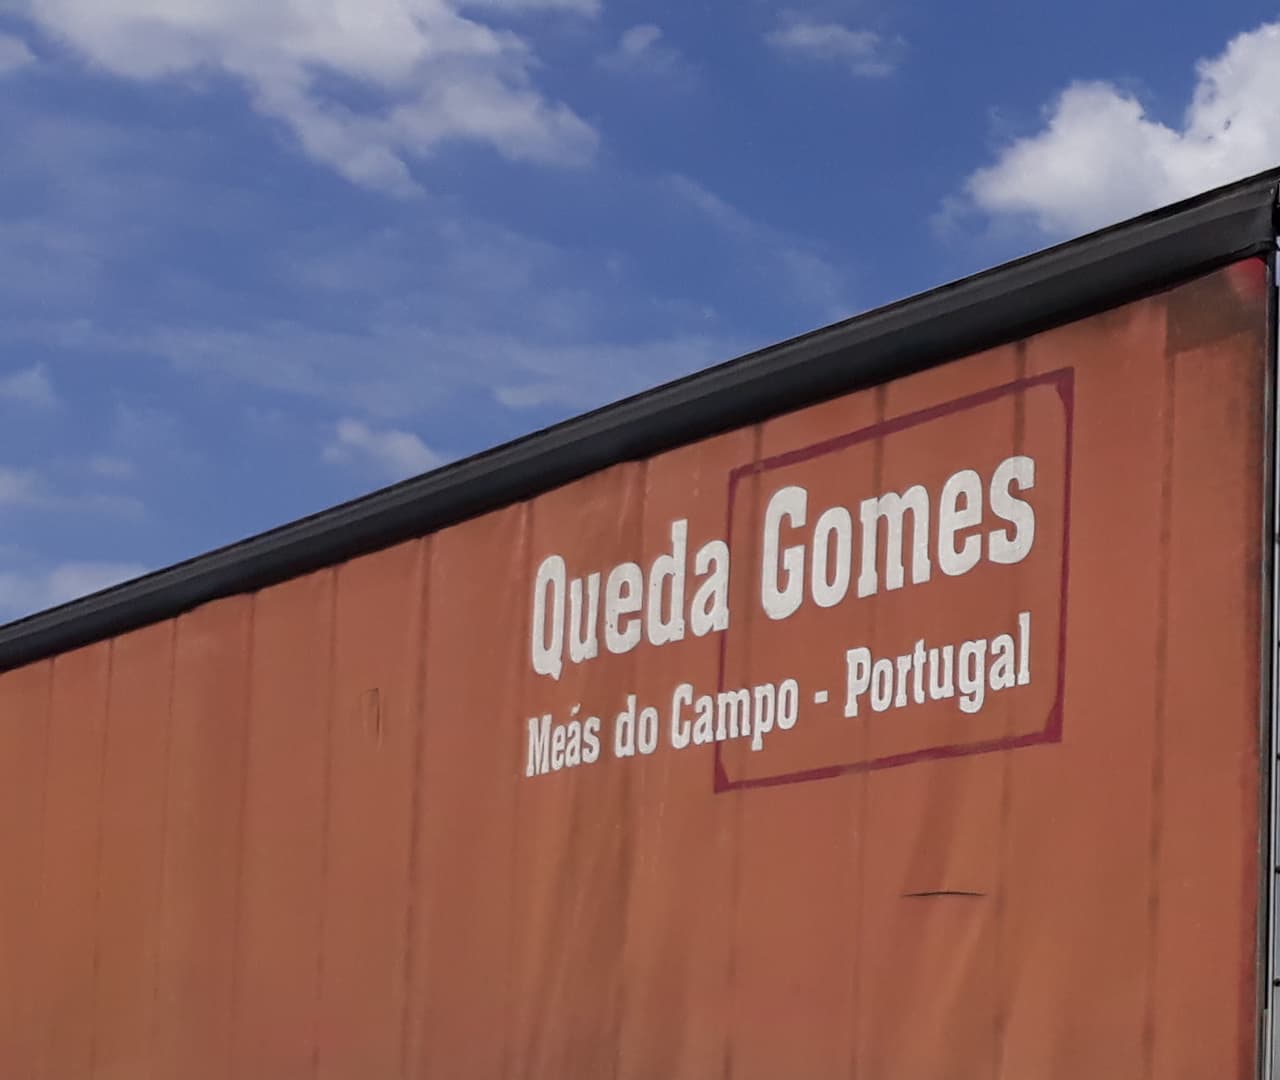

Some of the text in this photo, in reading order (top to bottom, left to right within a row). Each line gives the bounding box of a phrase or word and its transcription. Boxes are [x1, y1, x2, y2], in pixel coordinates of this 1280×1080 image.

[531, 455, 1036, 680] Queda Gomes
[525, 703, 601, 777] Meás
[614, 695, 658, 758] do
[671, 677, 799, 751] Campo
[844, 611, 1031, 718] Portugal
